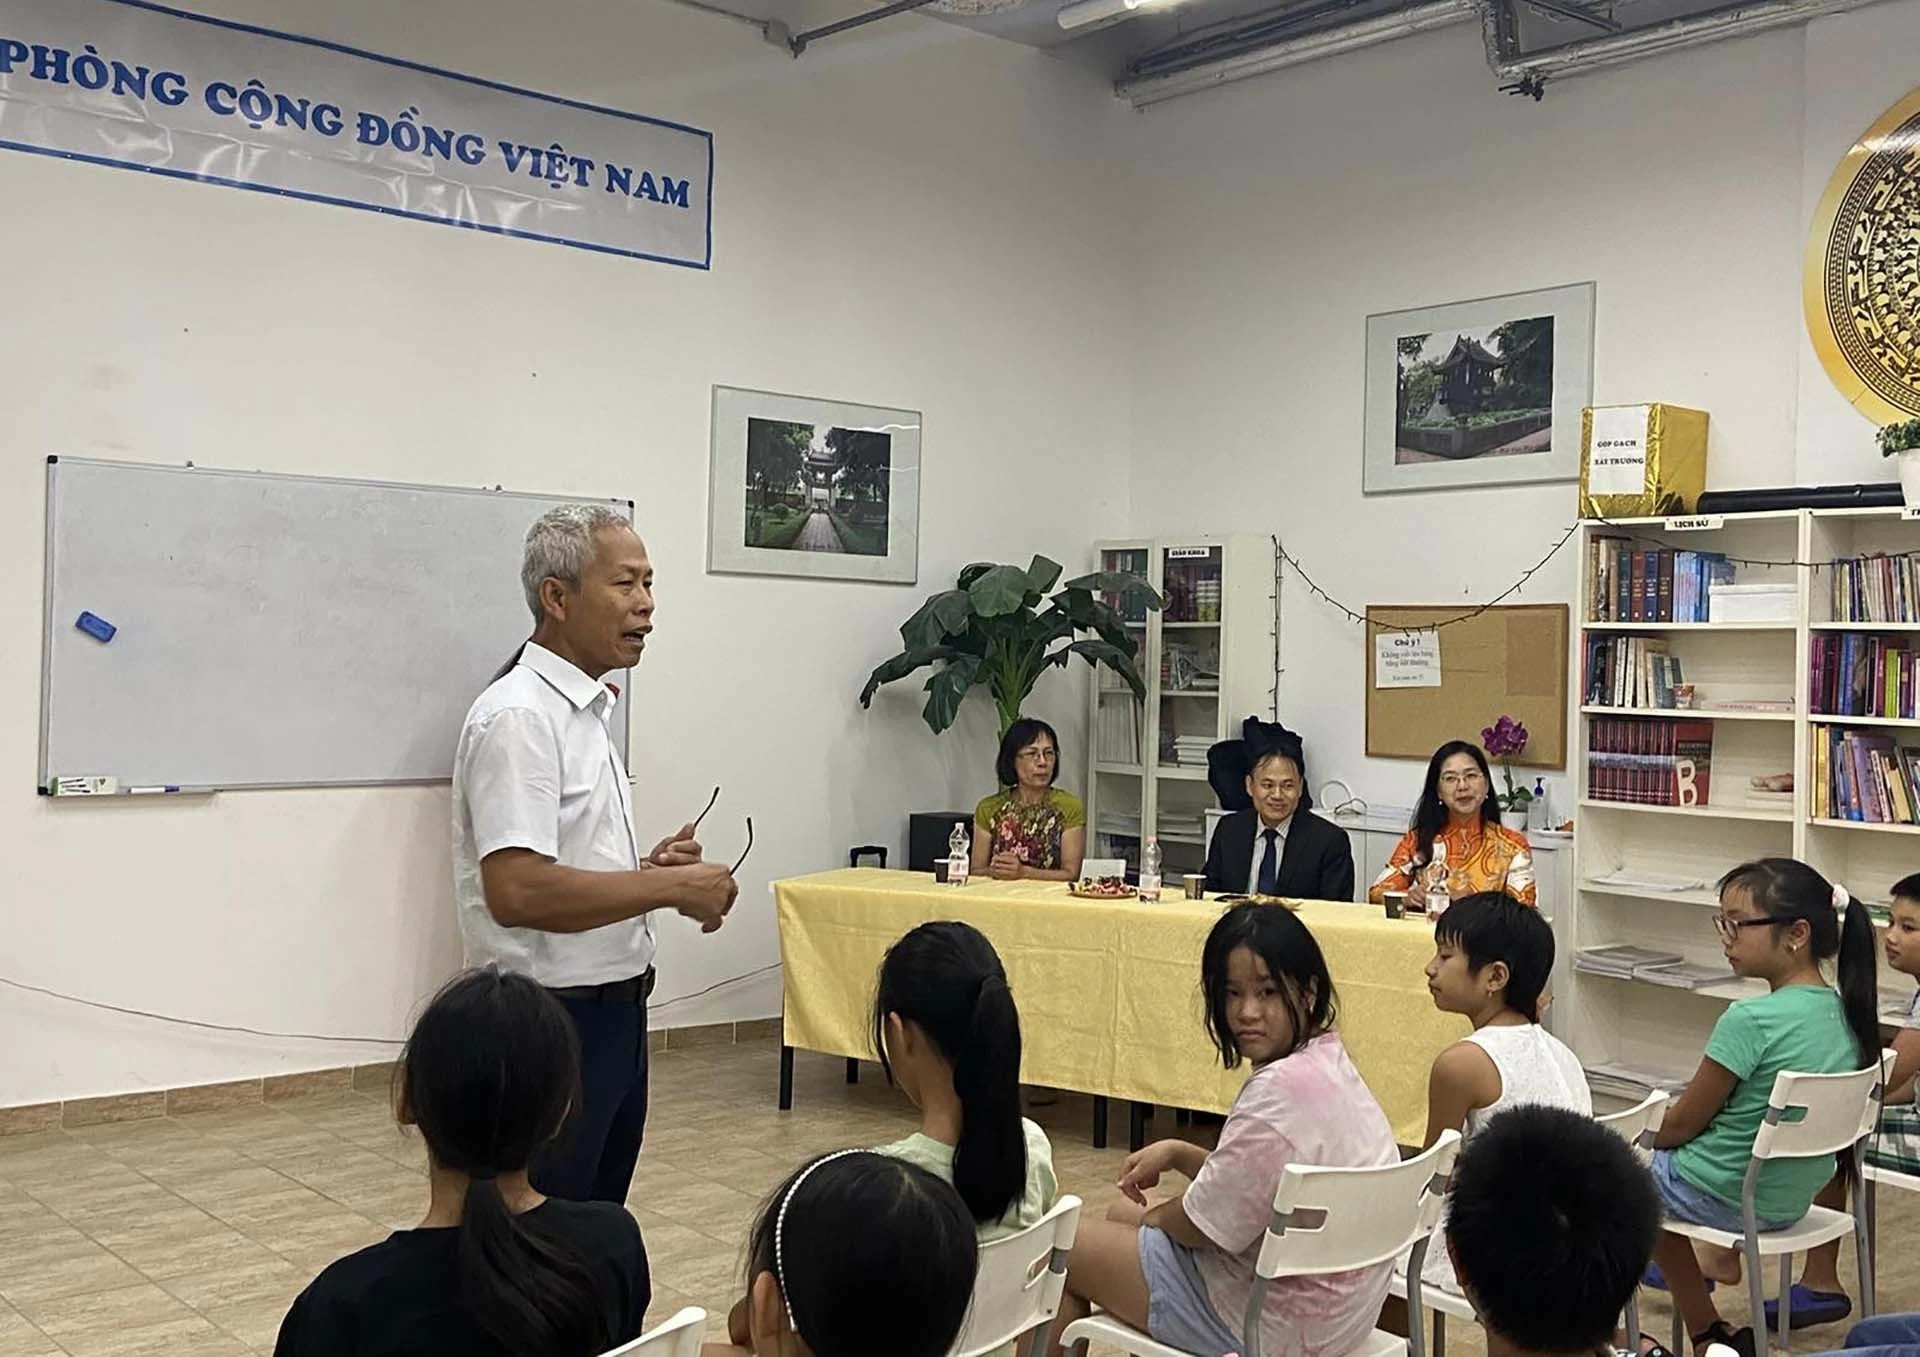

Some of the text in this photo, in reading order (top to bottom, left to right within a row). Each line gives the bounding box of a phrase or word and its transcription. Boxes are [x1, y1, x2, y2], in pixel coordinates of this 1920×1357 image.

[0, 39, 690, 208] PHÒNG CỘNG ĐỒNG VIỆT NAM
[1676, 760, 1698, 806] B
